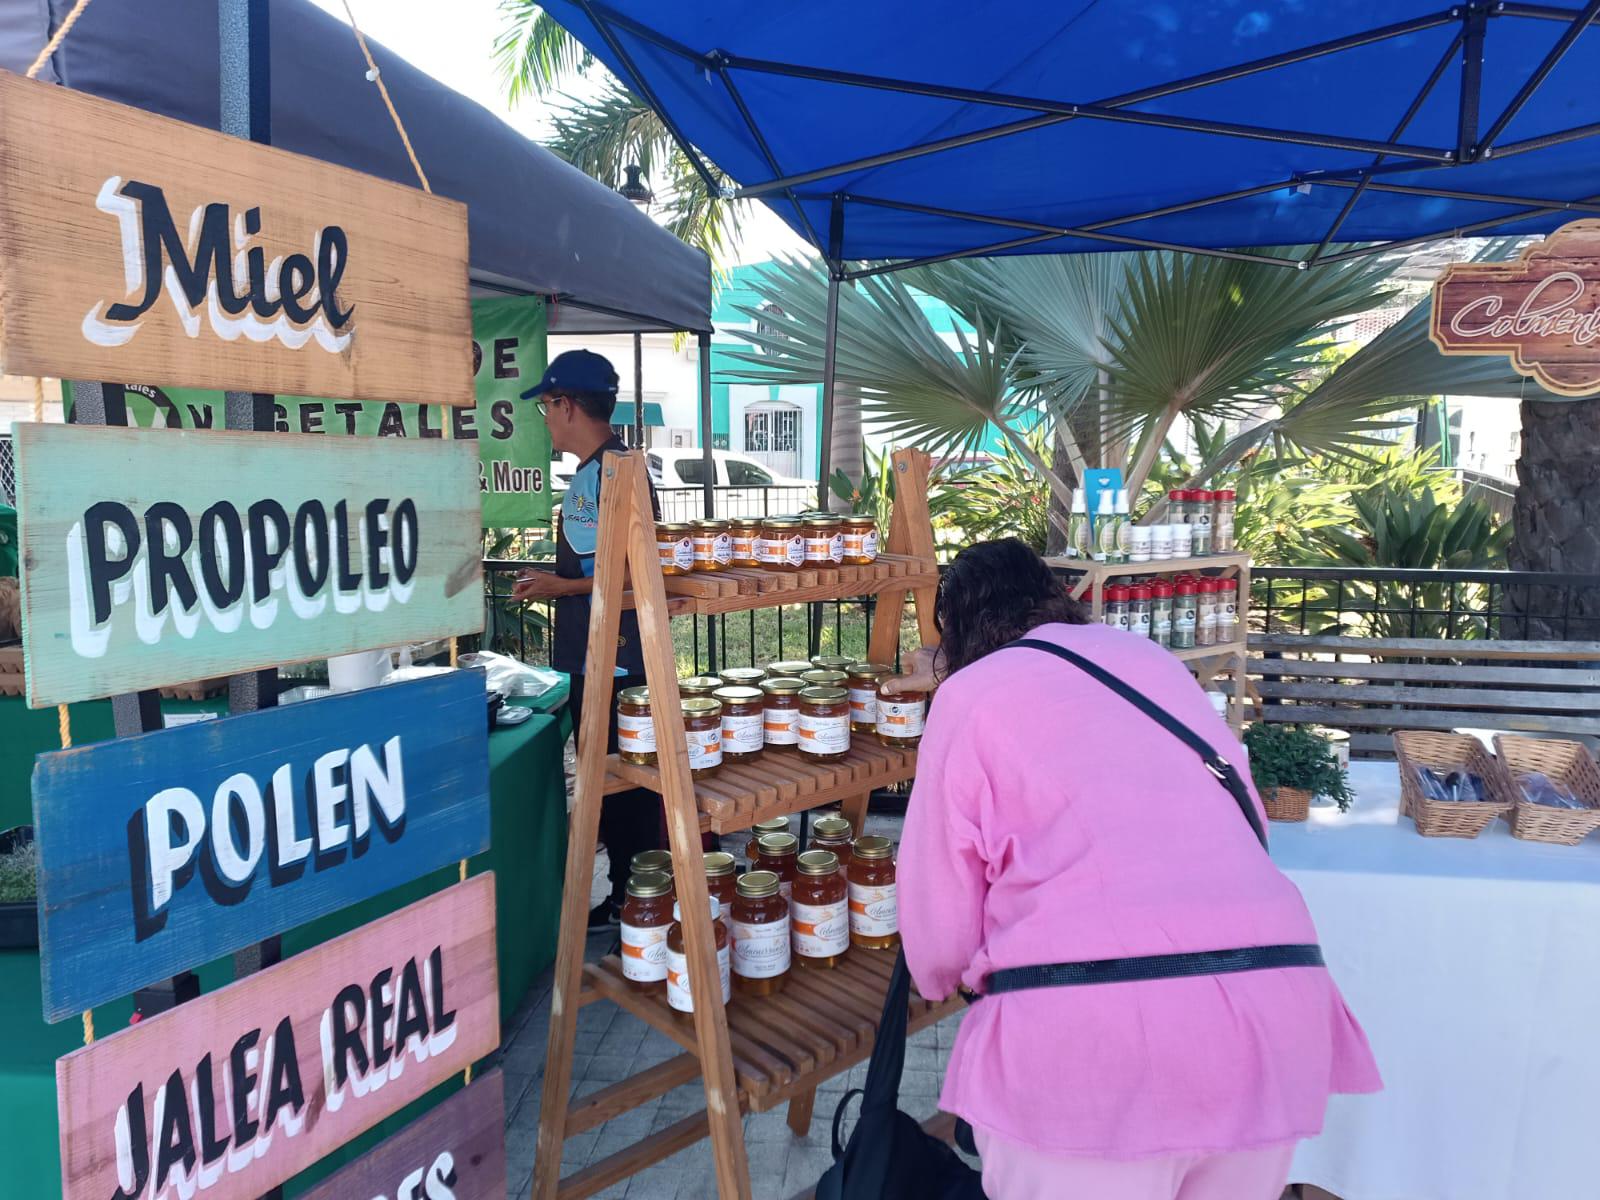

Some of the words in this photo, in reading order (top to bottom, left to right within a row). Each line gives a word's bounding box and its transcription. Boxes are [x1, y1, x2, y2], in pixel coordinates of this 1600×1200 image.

[104, 180, 356, 330] Miel
[186, 399, 514, 440] VGETALES
[493, 461, 542, 492] More
[83, 498, 419, 625] PROPOLEO
[145, 735, 407, 911] POLEN
[110, 1015, 305, 1200] JALEA
[331, 944, 457, 1090] REAL
